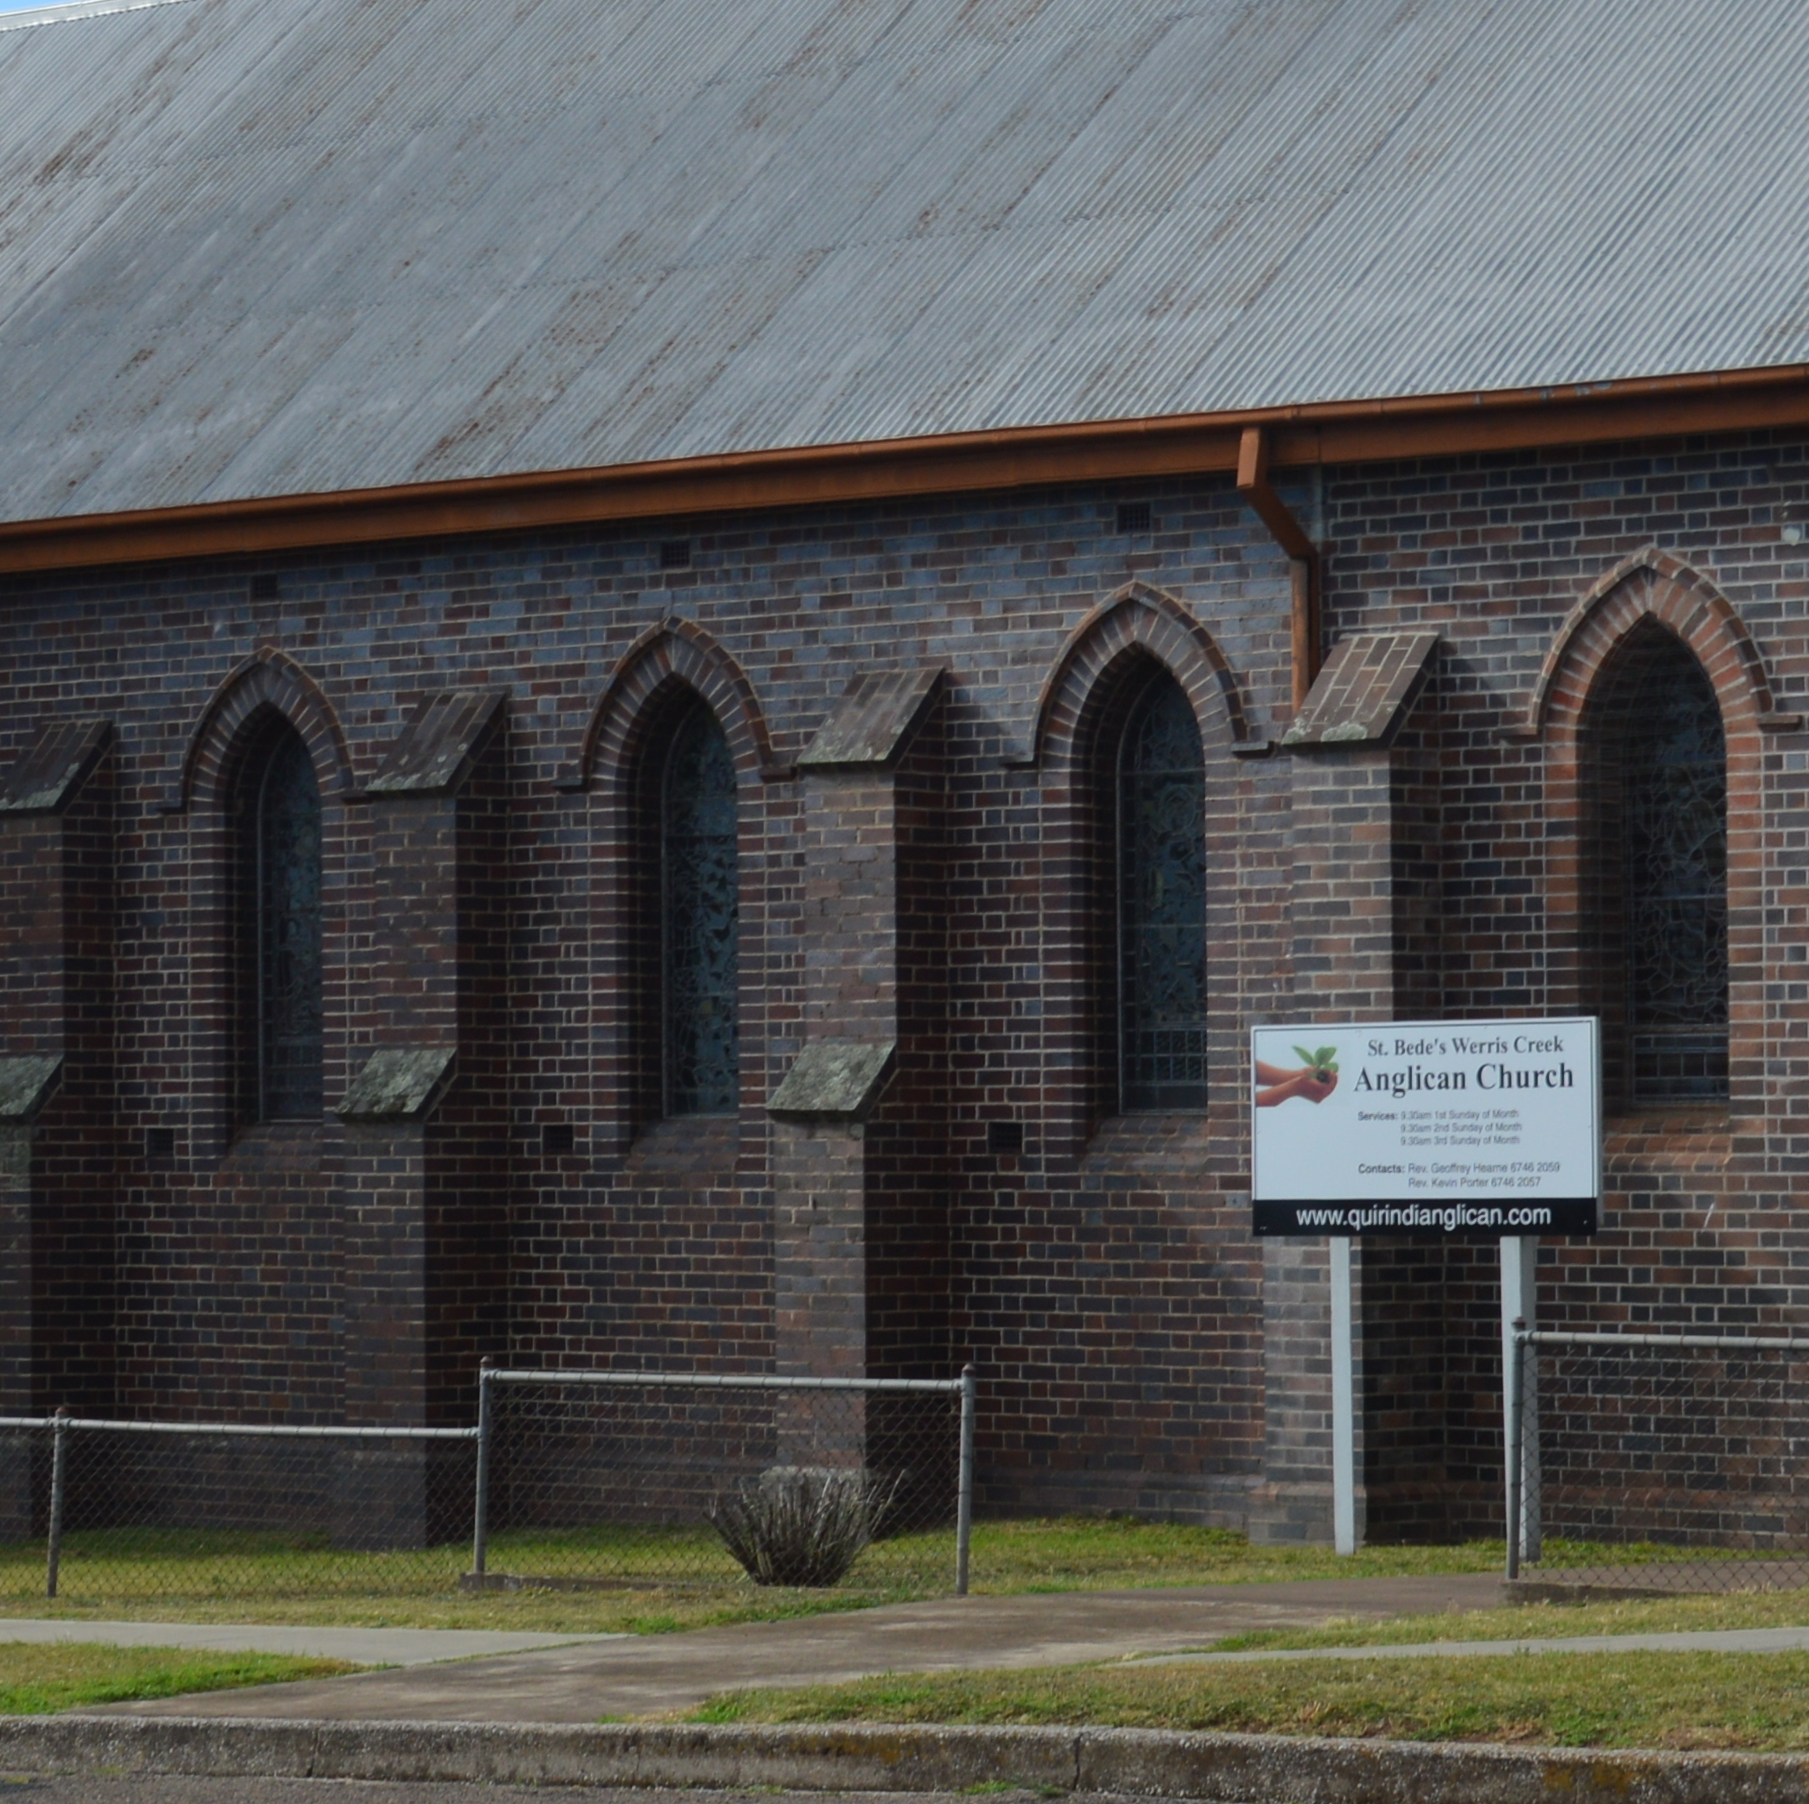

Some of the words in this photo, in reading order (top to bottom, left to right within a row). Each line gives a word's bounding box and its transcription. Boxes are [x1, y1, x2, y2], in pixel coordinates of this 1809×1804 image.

[1367, 1040, 1388, 1056] St.
[1394, 1038, 1446, 1056] Bede's
[1452, 1037, 1508, 1053] Werris
[1513, 1035, 1564, 1053] Creek
[1354, 1065, 1467, 1098] Anglican
[1476, 1062, 1574, 1090] Church
[1358, 1110, 1398, 1121] Services:
[1435, 1110, 1446, 1119] 1st
[1450, 1110, 1479, 1120] Sunday
[1482, 1109, 1490, 1119] of
[1493, 1108, 1519, 1118] Month
[1434, 1123, 1449, 1132] 2nd
[1452, 1123, 1482, 1133] Sunday
[1485, 1122, 1493, 1132] of
[1496, 1122, 1522, 1131] Month
[1434, 1136, 1447, 1145] 3rd
[1450, 1136, 1480, 1146] Sunday
[1483, 1135, 1491, 1145] of
[1494, 1135, 1520, 1144] Month
[1358, 1163, 1405, 1174] Contacts:
[1408, 1163, 1427, 1173] Rev.
[1431, 1163, 1471, 1175] Geoffrey
[1409, 1178, 1428, 1188] Rev.
[1431, 1177, 1458, 1187] Kevin
[1460, 1177, 1489, 1187] Porter
[1296, 1204, 1551, 1231] www.quirindianglican.com
